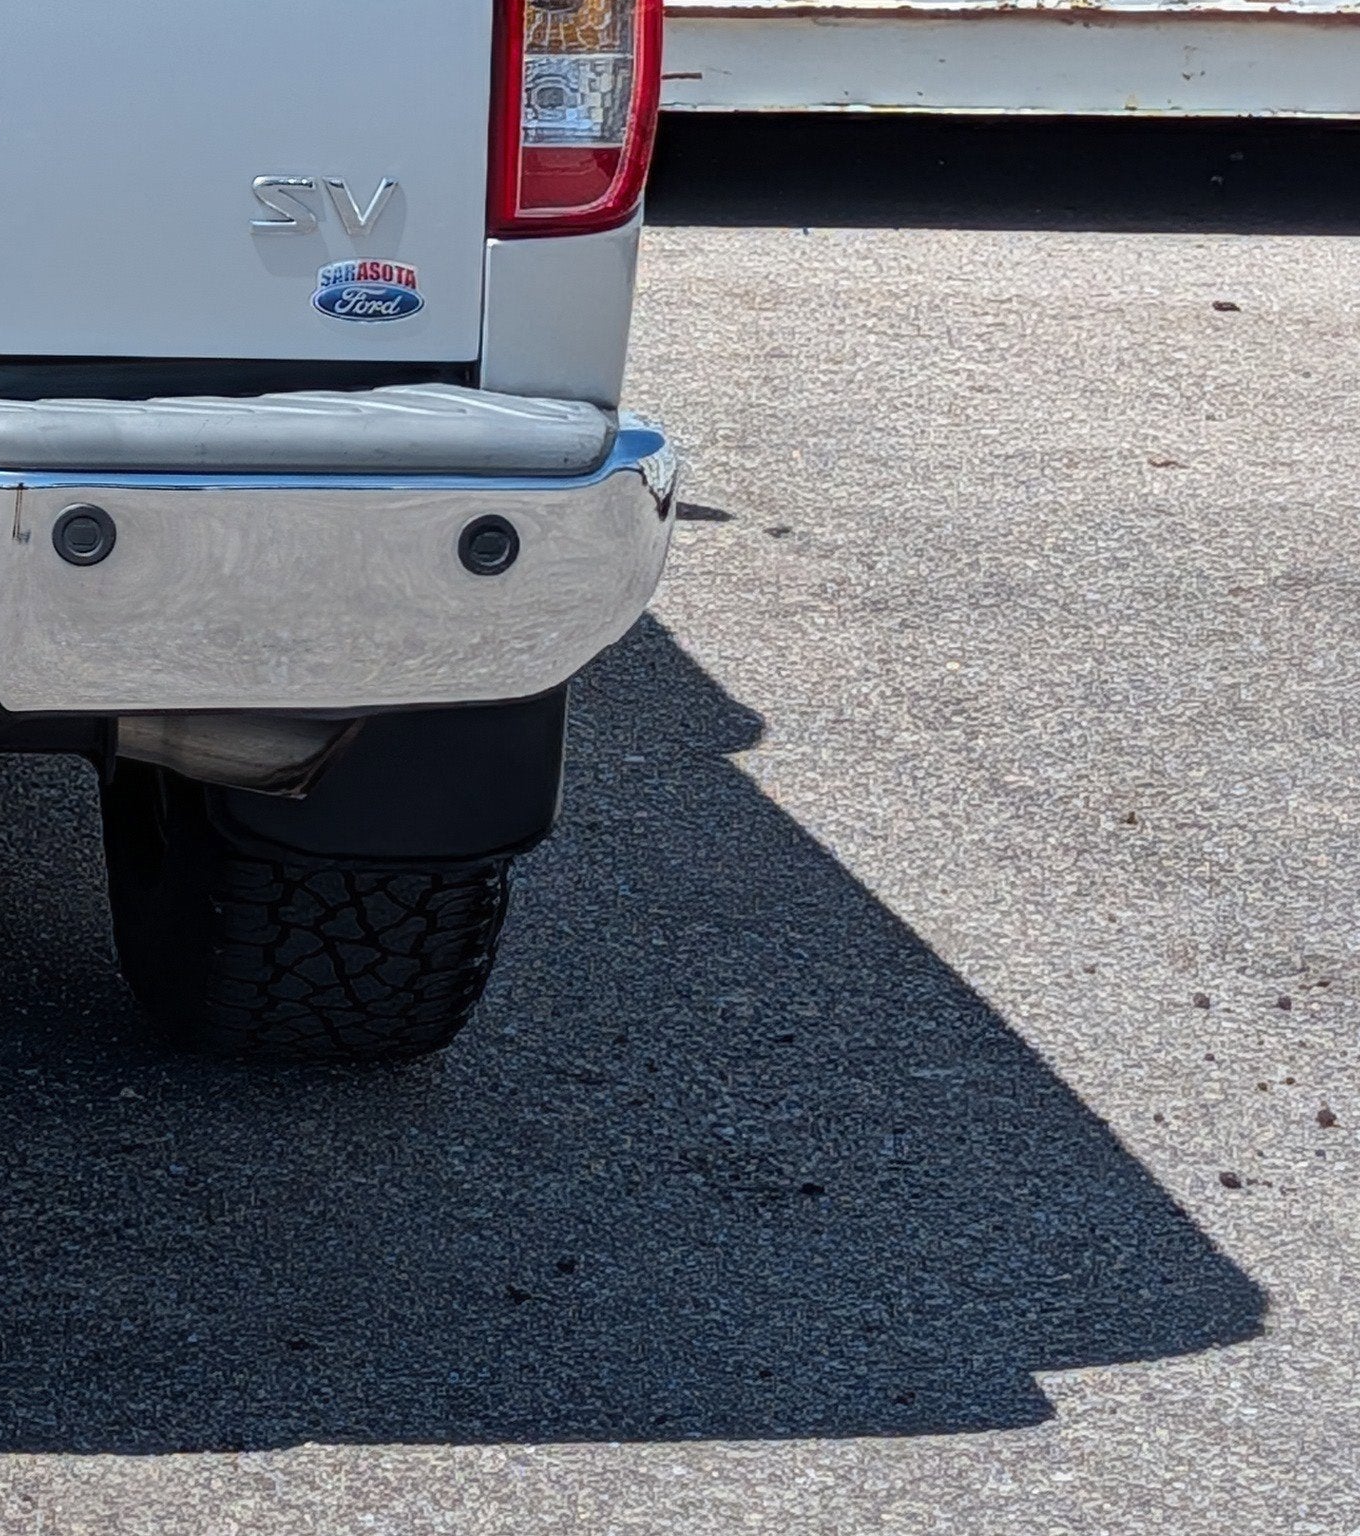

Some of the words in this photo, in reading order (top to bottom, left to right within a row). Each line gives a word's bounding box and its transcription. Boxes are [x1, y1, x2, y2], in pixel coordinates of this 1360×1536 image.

[249, 175, 399, 235] SV
[320, 261, 417, 290] SARASOTA
[334, 287, 402, 315] Ford
